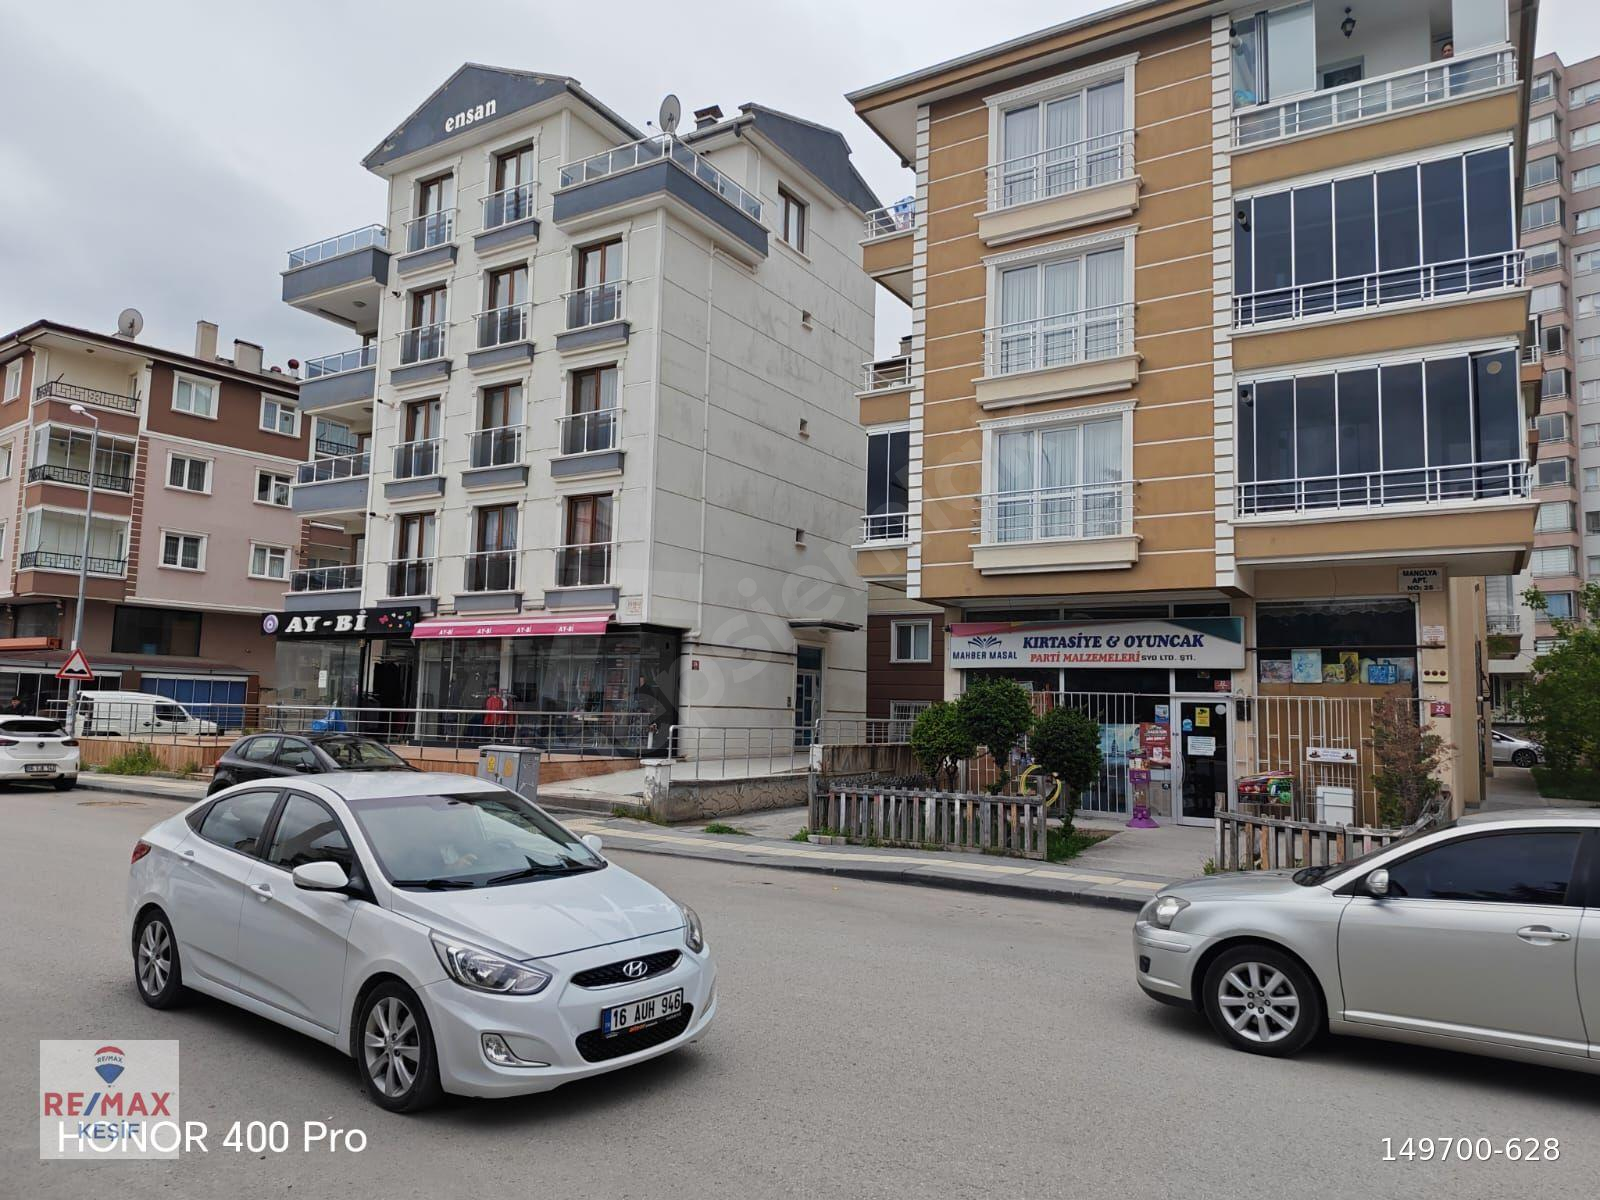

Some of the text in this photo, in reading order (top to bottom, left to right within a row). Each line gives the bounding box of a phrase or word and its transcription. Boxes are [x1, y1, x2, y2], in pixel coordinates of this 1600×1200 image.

[445, 99, 497, 132] ensan
[1022, 632, 1205, 649] KIRTASİYE & OYUNCAK
[952, 651, 1018, 660] MAHBER MASAL
[1030, 650, 1061, 663] PARTİ
[1063, 650, 1141, 663] MALZEMELERİ
[1435, 704, 1446, 713] 22
[613, 1008, 627, 1028] 16
[634, 1000, 655, 1022] AUH
[661, 993, 681, 1014] 946
